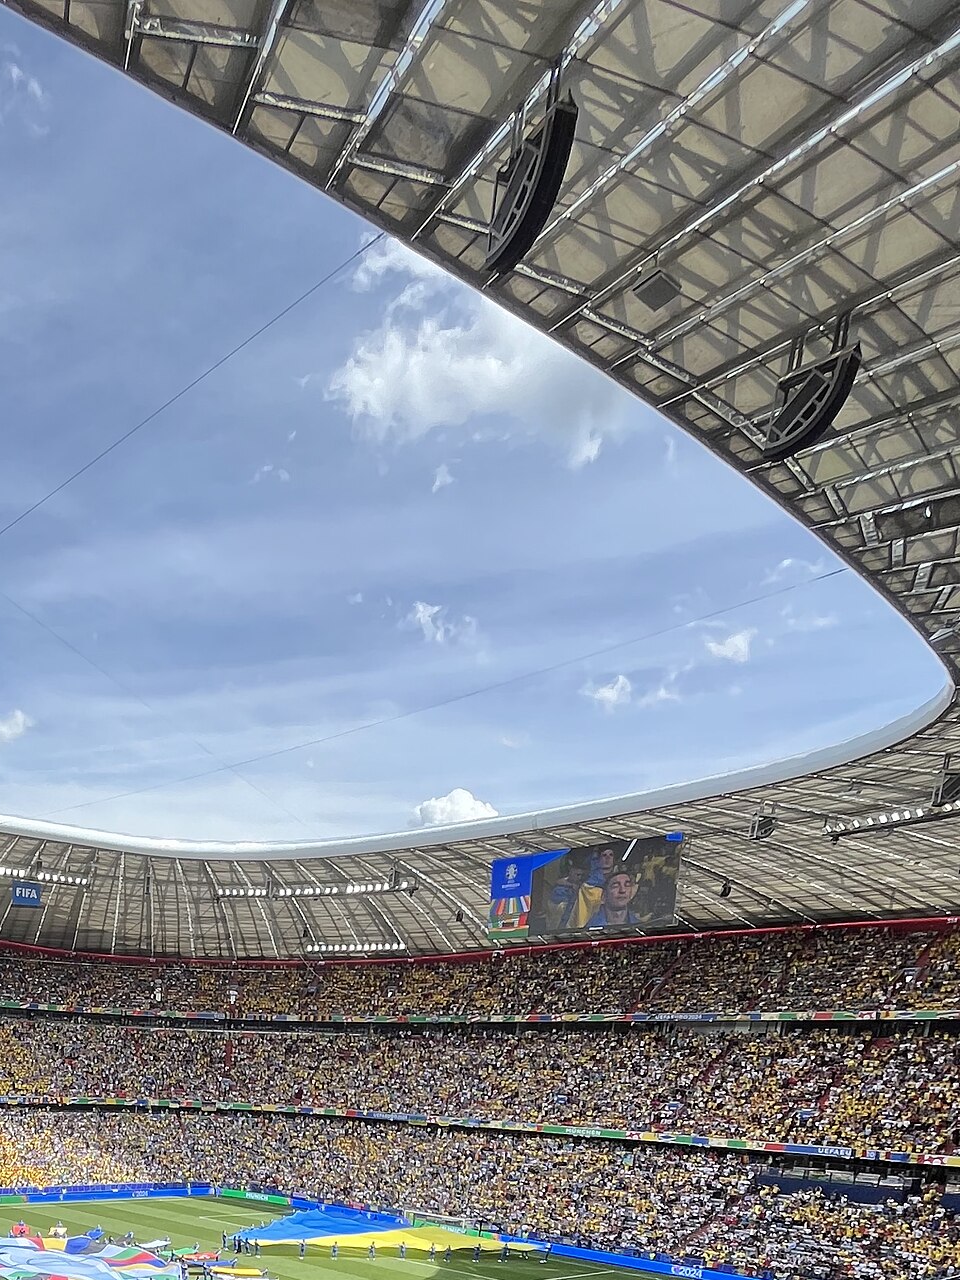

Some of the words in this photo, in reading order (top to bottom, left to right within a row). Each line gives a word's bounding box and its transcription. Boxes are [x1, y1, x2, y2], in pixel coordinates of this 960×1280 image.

[16, 887, 37, 899] FIFA
[818, 1147, 852, 1156] UEFAEU
[679, 1266, 703, 1279] 2024
